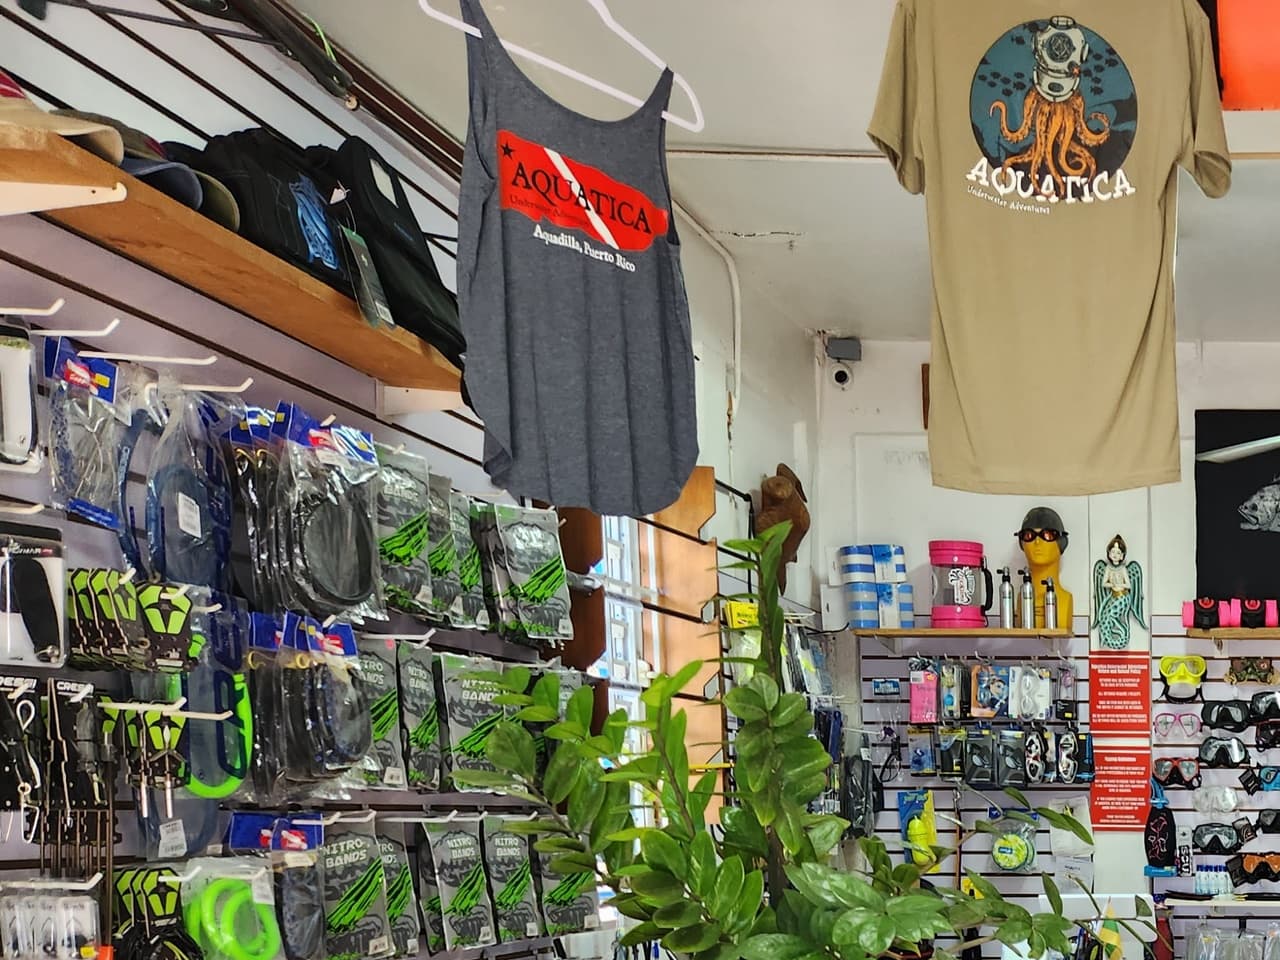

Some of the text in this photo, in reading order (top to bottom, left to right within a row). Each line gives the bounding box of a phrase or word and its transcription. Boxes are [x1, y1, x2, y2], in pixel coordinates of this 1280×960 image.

[966, 156, 1136, 204] AQUATICA
[512, 162, 651, 234] AQUATICA
[584, 241, 614, 263] Puerto
[616, 253, 636, 273] Rico
[321, 840, 364, 854] NITRO
[447, 838, 472, 848] NITRO
[495, 837, 519, 847] NITRO
[325, 850, 367, 868] BANDS
